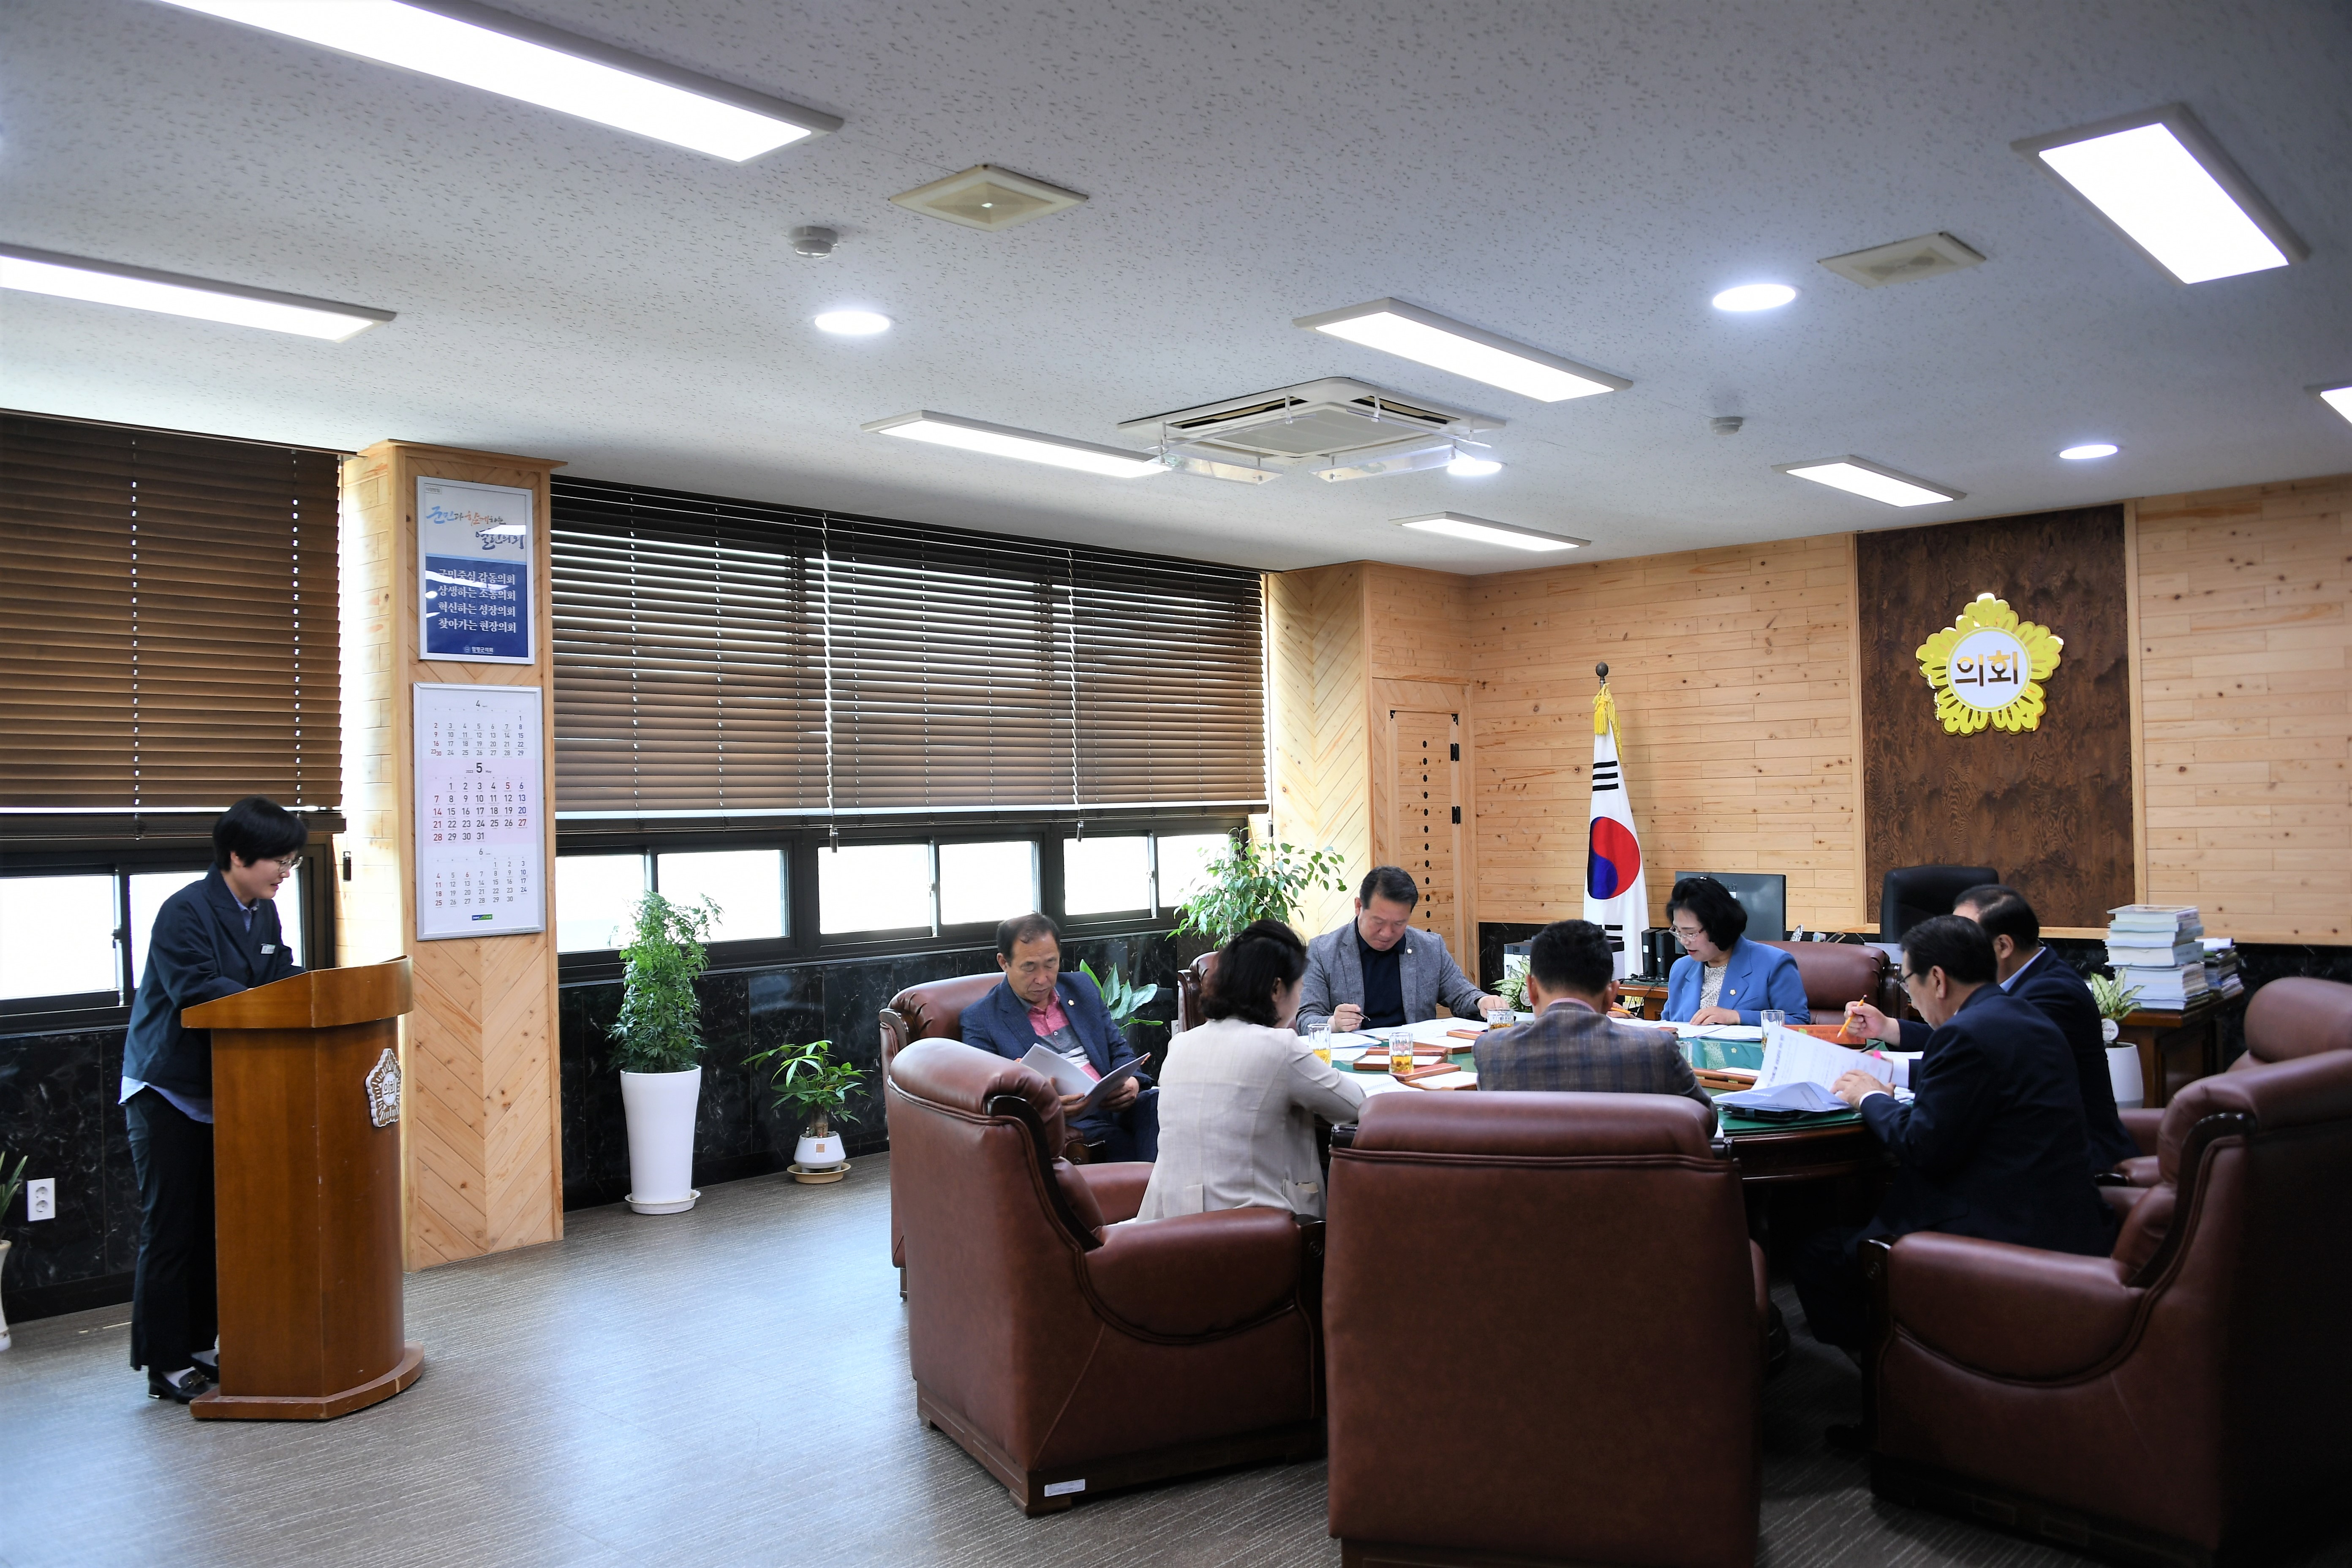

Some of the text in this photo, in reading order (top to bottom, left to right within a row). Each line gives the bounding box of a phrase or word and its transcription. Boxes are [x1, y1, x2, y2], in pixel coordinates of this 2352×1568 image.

[478, 572, 515, 585] 감동의회
[438, 585, 477, 599] 상생하는
[438, 601, 516, 617] 혁신하는 성장의회
[438, 618, 516, 633] 찾아가는 현장의회
[1955, 650, 2018, 687] 의회
[476, 762, 483, 773] 5
[477, 782, 482, 790] 3
[434, 795, 439, 803] 7
[463, 795, 468, 803] 9
[433, 808, 442, 816] 14
[462, 807, 470, 815] 16
[476, 807, 485, 815] 17
[504, 806, 513, 814] 19
[433, 820, 441, 828] 21
[462, 820, 471, 828] 23
[476, 819, 485, 828] 24
[490, 819, 499, 827] 25
[518, 819, 527, 827] 27
[448, 833, 457, 841] 29
[384, 1079, 395, 1097] 의회
